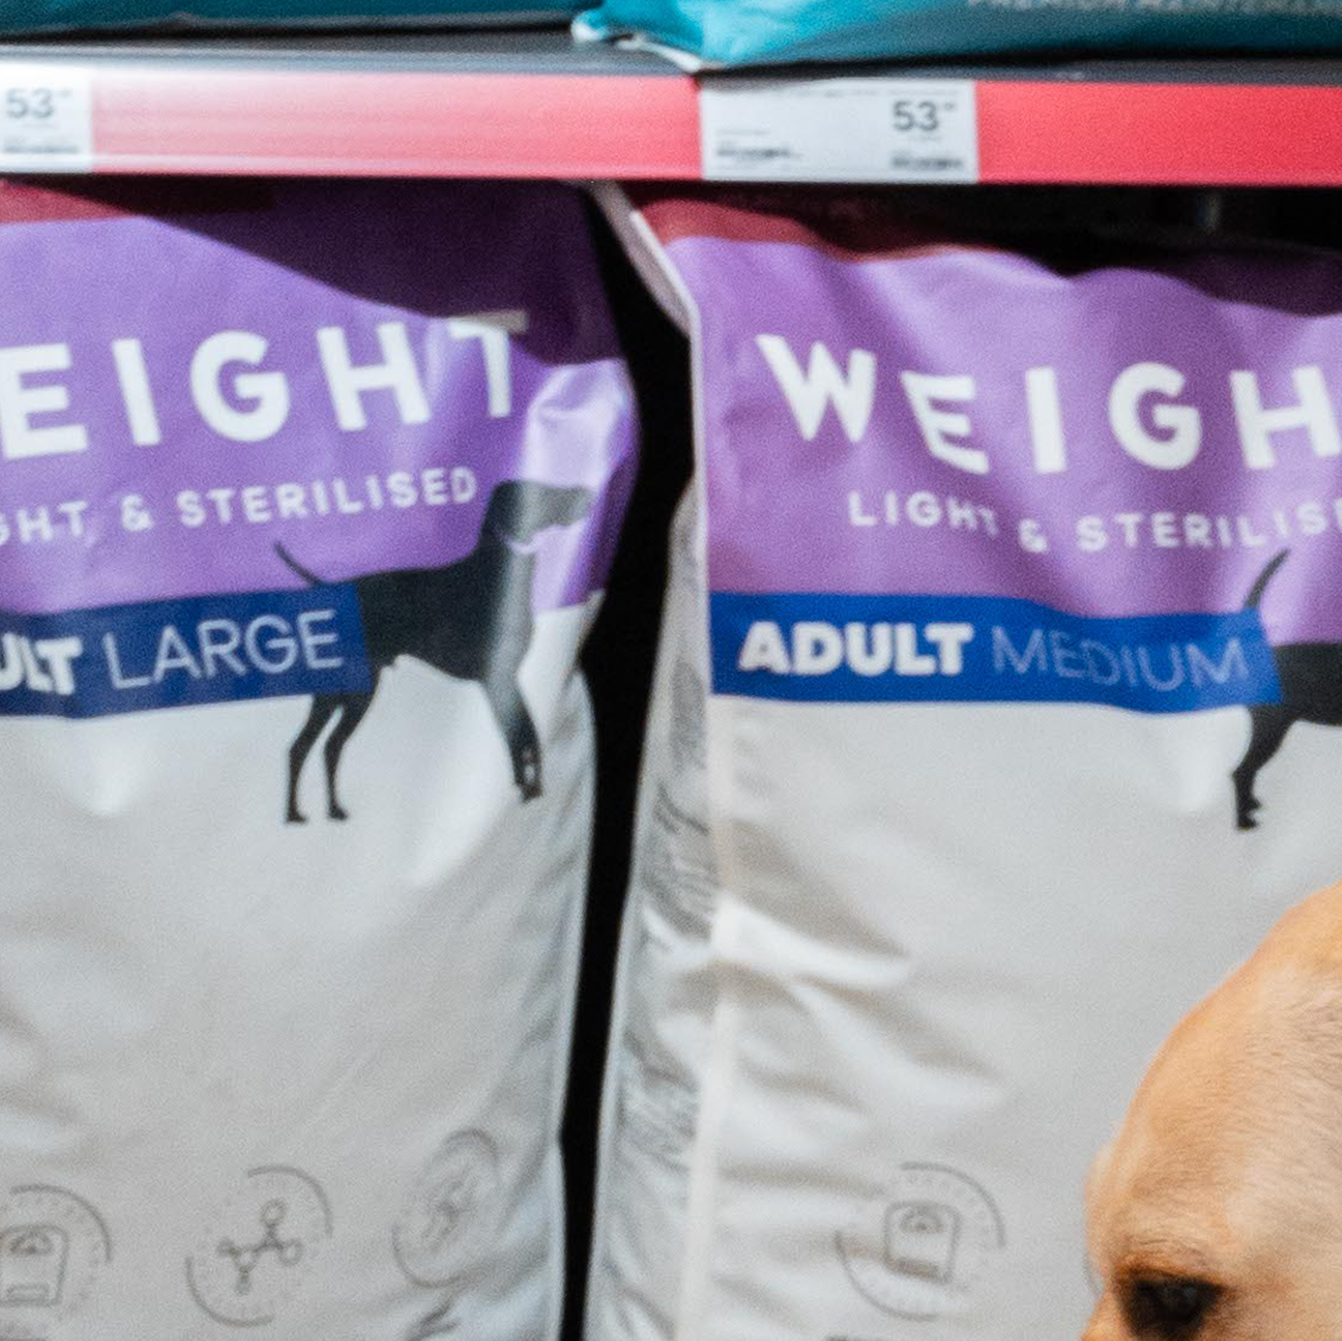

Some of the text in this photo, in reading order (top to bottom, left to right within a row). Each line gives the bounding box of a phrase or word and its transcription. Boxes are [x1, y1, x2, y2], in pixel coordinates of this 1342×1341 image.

[120, 494, 154, 533] &
[177, 466, 479, 528] STERILISED
[848, 489, 998, 538] LIGHT
[1020, 518, 1049, 554] &
[103, 607, 345, 691] LARGE
[738, 619, 1251, 693] ADULT MEDIUM
